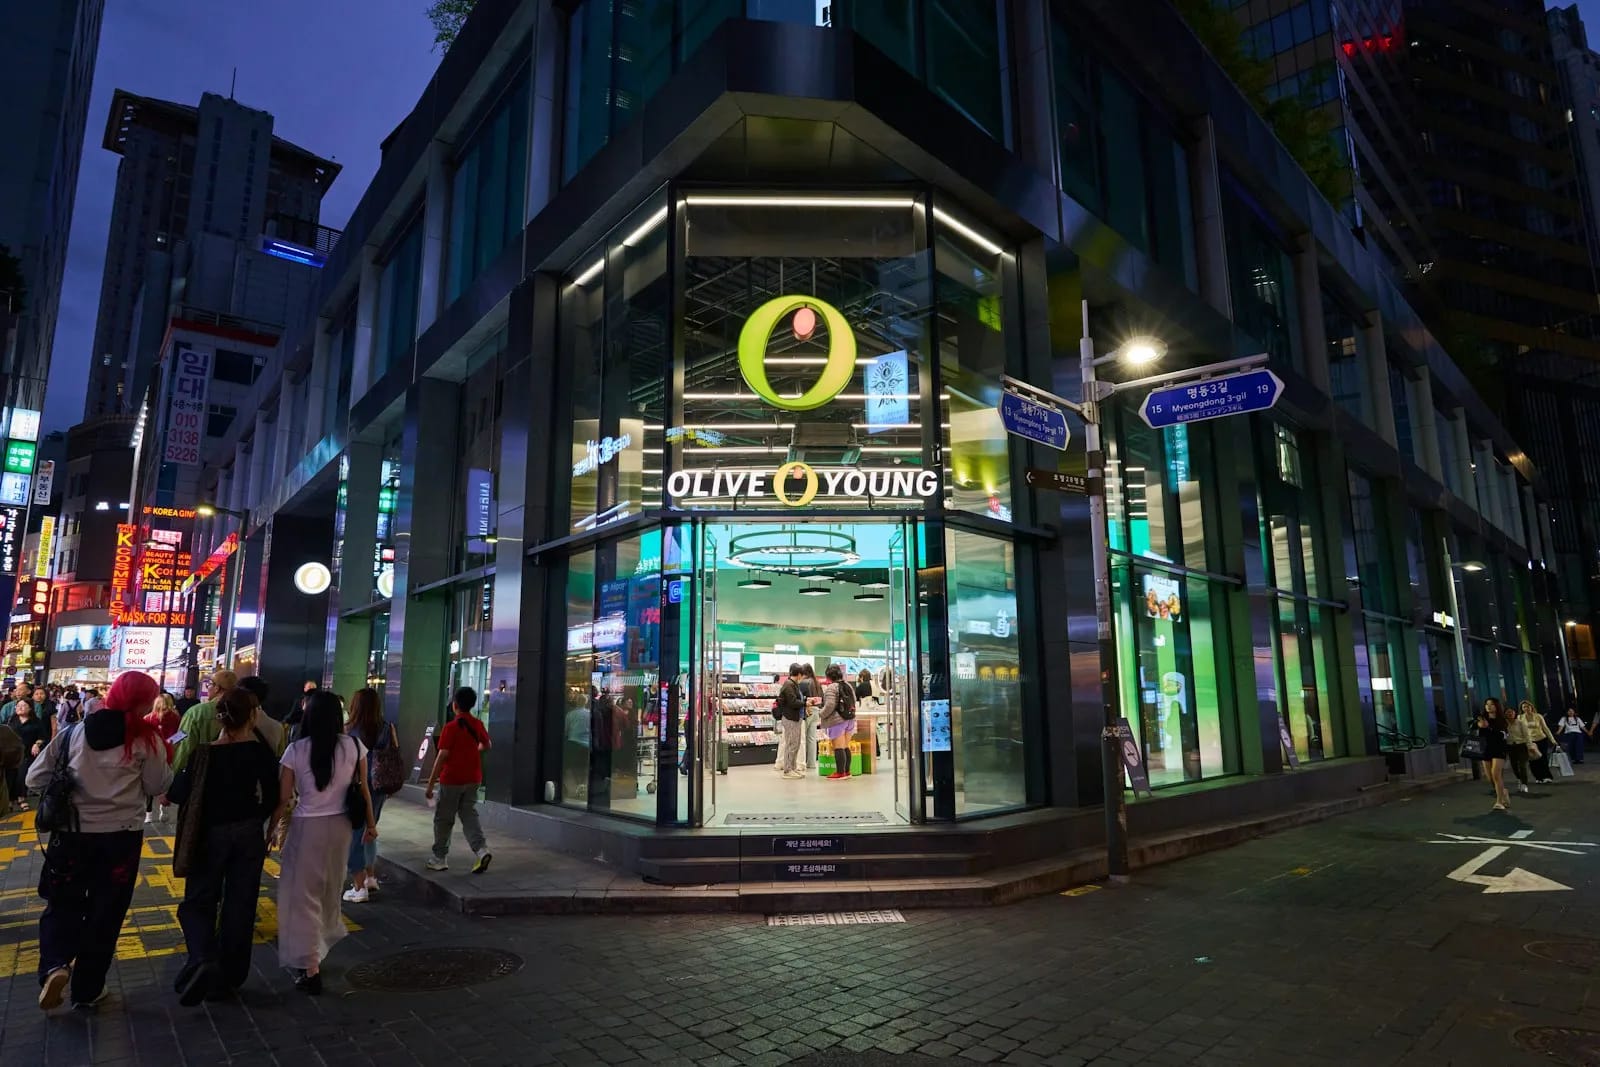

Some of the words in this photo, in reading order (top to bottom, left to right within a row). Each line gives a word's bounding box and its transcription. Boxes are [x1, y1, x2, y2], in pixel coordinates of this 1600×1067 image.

[178, 352, 209, 401] 임대
[1186, 381, 1228, 399] 명동3길
[1256, 384, 1269, 394] 19
[1151, 404, 1163, 414] 15
[1171, 396, 1226, 413] Myeongdong
[1227, 391, 1247, 403] 3-gil
[1004, 406, 1012, 416] 13
[1020, 402, 1049, 423] 명동7가길
[175, 412, 198, 428] 010
[169, 428, 199, 446] 3138
[1057, 426, 1064, 436] 17
[166, 445, 198, 463] 5226
[666, 470, 766, 498] OLIVE
[823, 470, 939, 497] YOUNG
[13, 481, 27, 503] 내과
[152, 507, 179, 517] KOREA
[145, 551, 173, 559] BEAUTY
[119, 612, 146, 624] MASK
[149, 612, 166, 624] FOR
[786, 840, 799, 848] 계단
[799, 839, 832, 848] 조심하세요!
[787, 865, 801, 873] 계단
[802, 864, 836, 873] 조심하세요!
